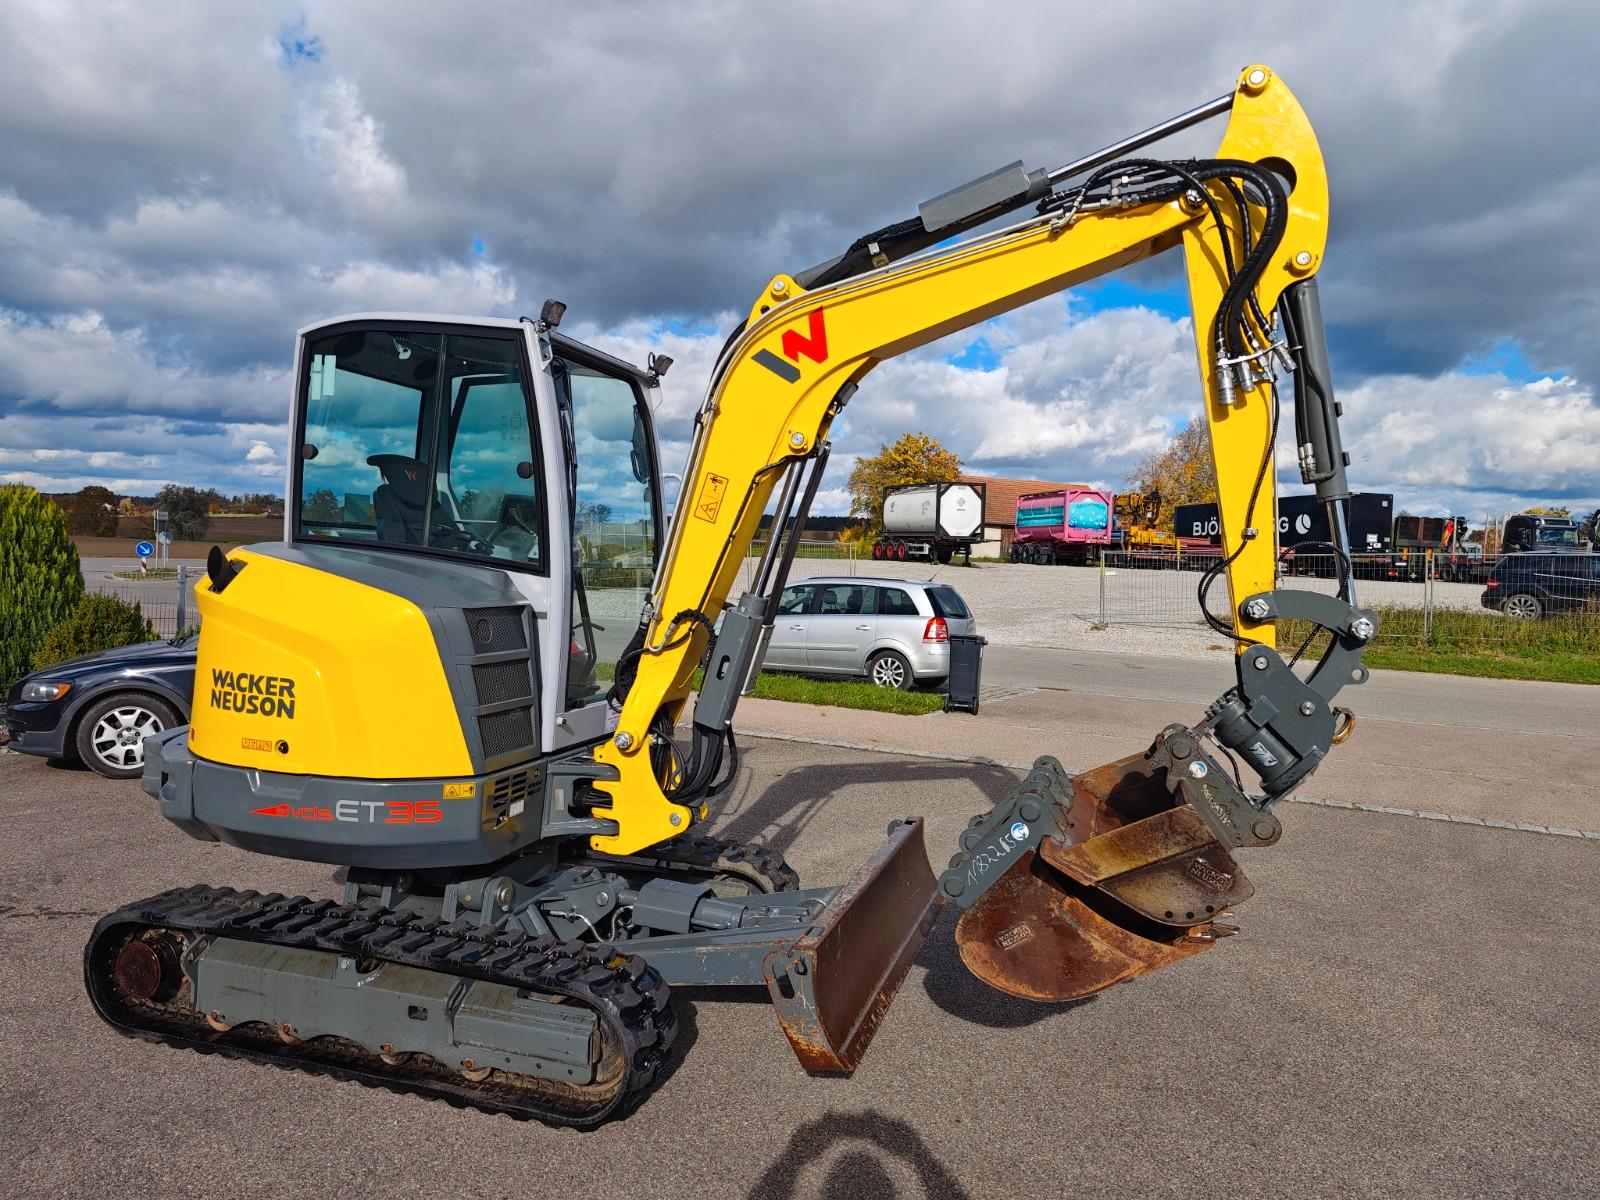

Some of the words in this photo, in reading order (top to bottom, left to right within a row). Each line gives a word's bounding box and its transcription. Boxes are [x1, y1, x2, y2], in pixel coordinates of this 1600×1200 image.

[1192, 516, 1221, 537] BJÖ
[212, 668, 296, 698] WACKER
[210, 688, 295, 719] NEUSON
